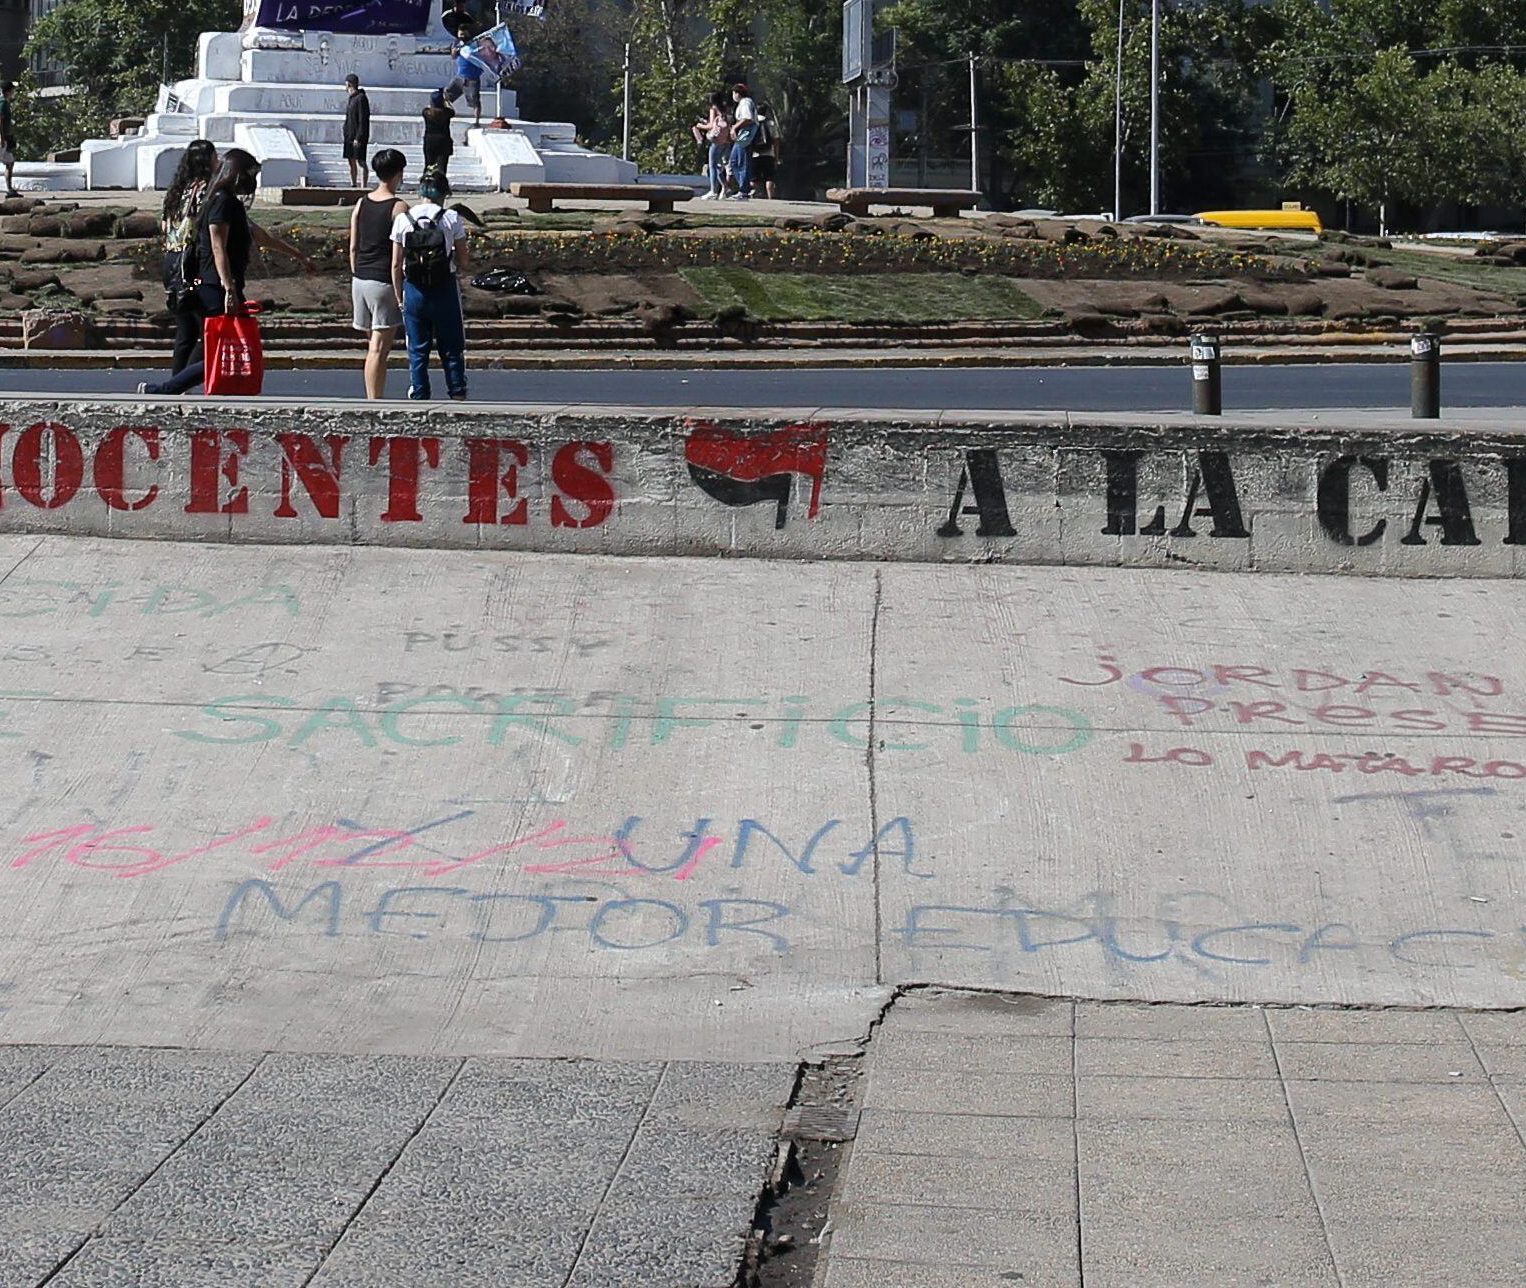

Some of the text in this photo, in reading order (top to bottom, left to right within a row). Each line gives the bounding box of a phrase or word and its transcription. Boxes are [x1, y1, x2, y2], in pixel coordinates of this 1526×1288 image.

[275, 2, 298, 23] LA
[937, 448, 1017, 537] A
[1100, 448, 1252, 539] LA
[171, 694, 1094, 755] SACRIFICIO
[1122, 742, 1216, 768] LO
[212, 877, 792, 953] MEJOR
